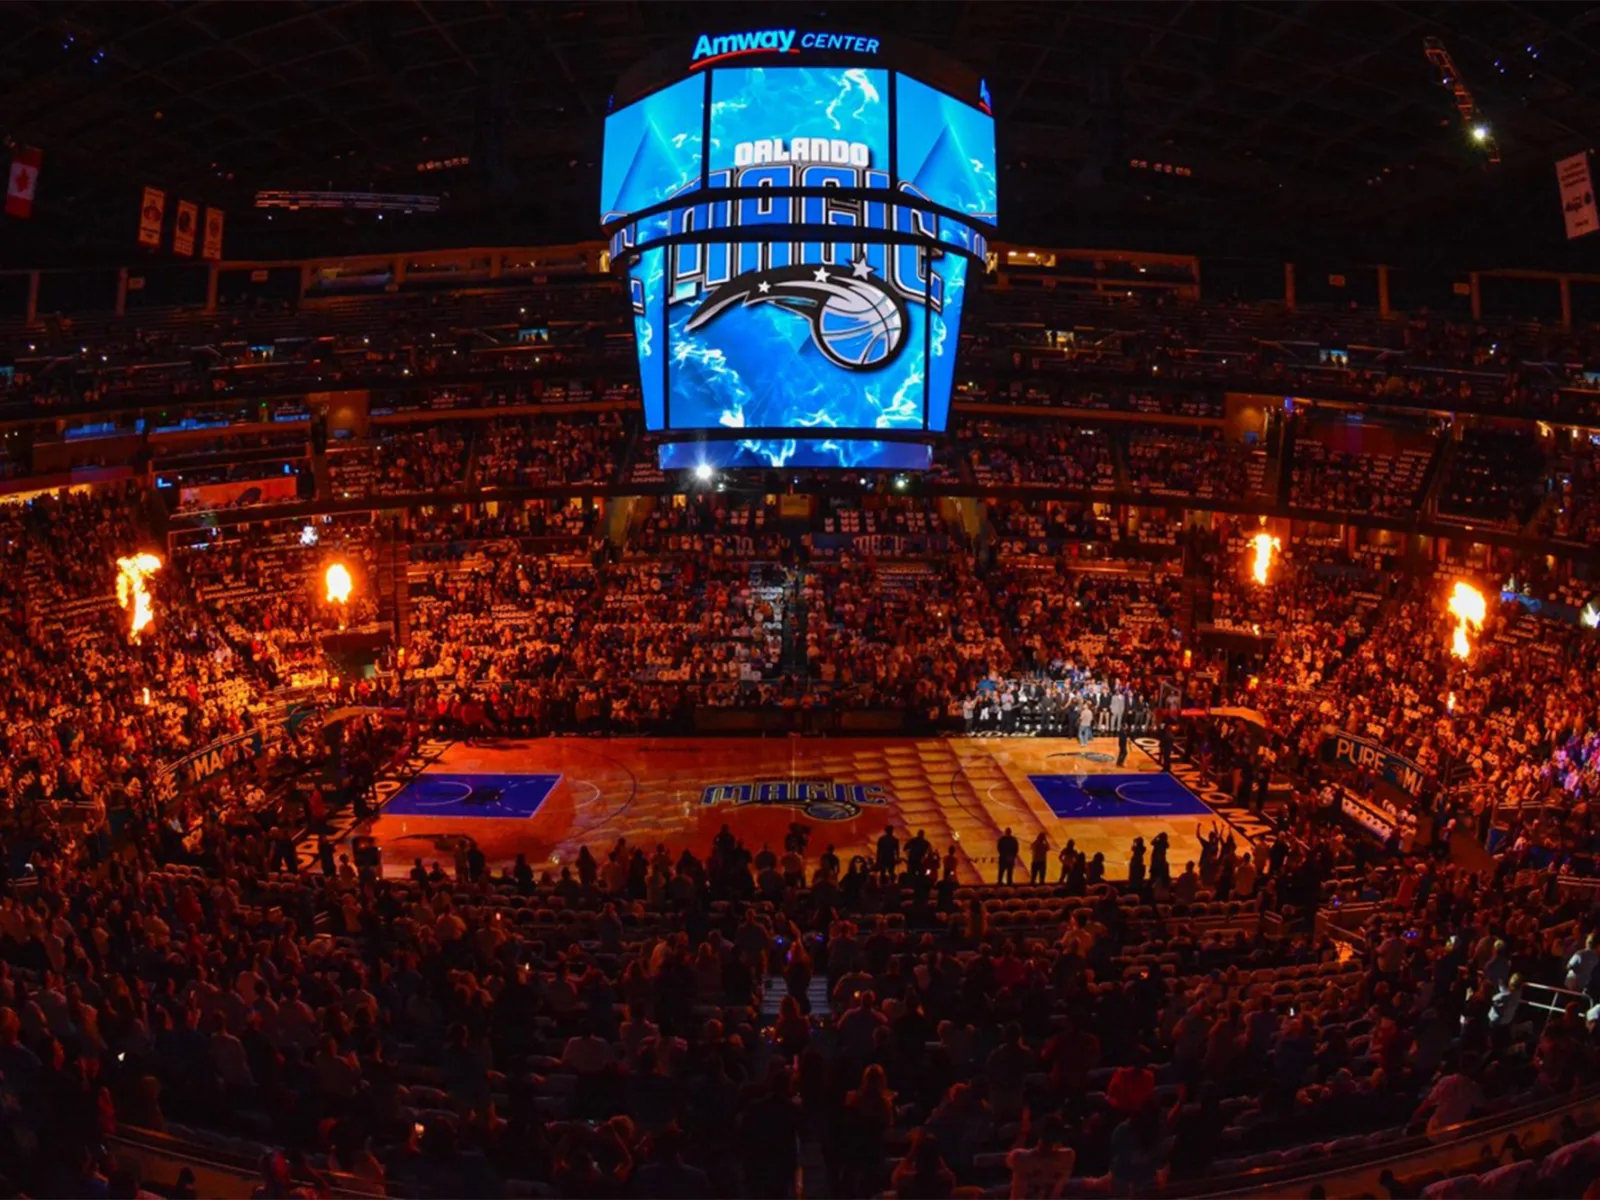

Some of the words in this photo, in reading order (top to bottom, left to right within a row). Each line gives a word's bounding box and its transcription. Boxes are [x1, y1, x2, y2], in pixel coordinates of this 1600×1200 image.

[692, 29, 797, 60] Amway
[800, 33, 880, 54] CENTER
[734, 138, 869, 166] ORLANDO
[1335, 738, 1387, 776] PURE
[702, 783, 888, 807] MAGIC
